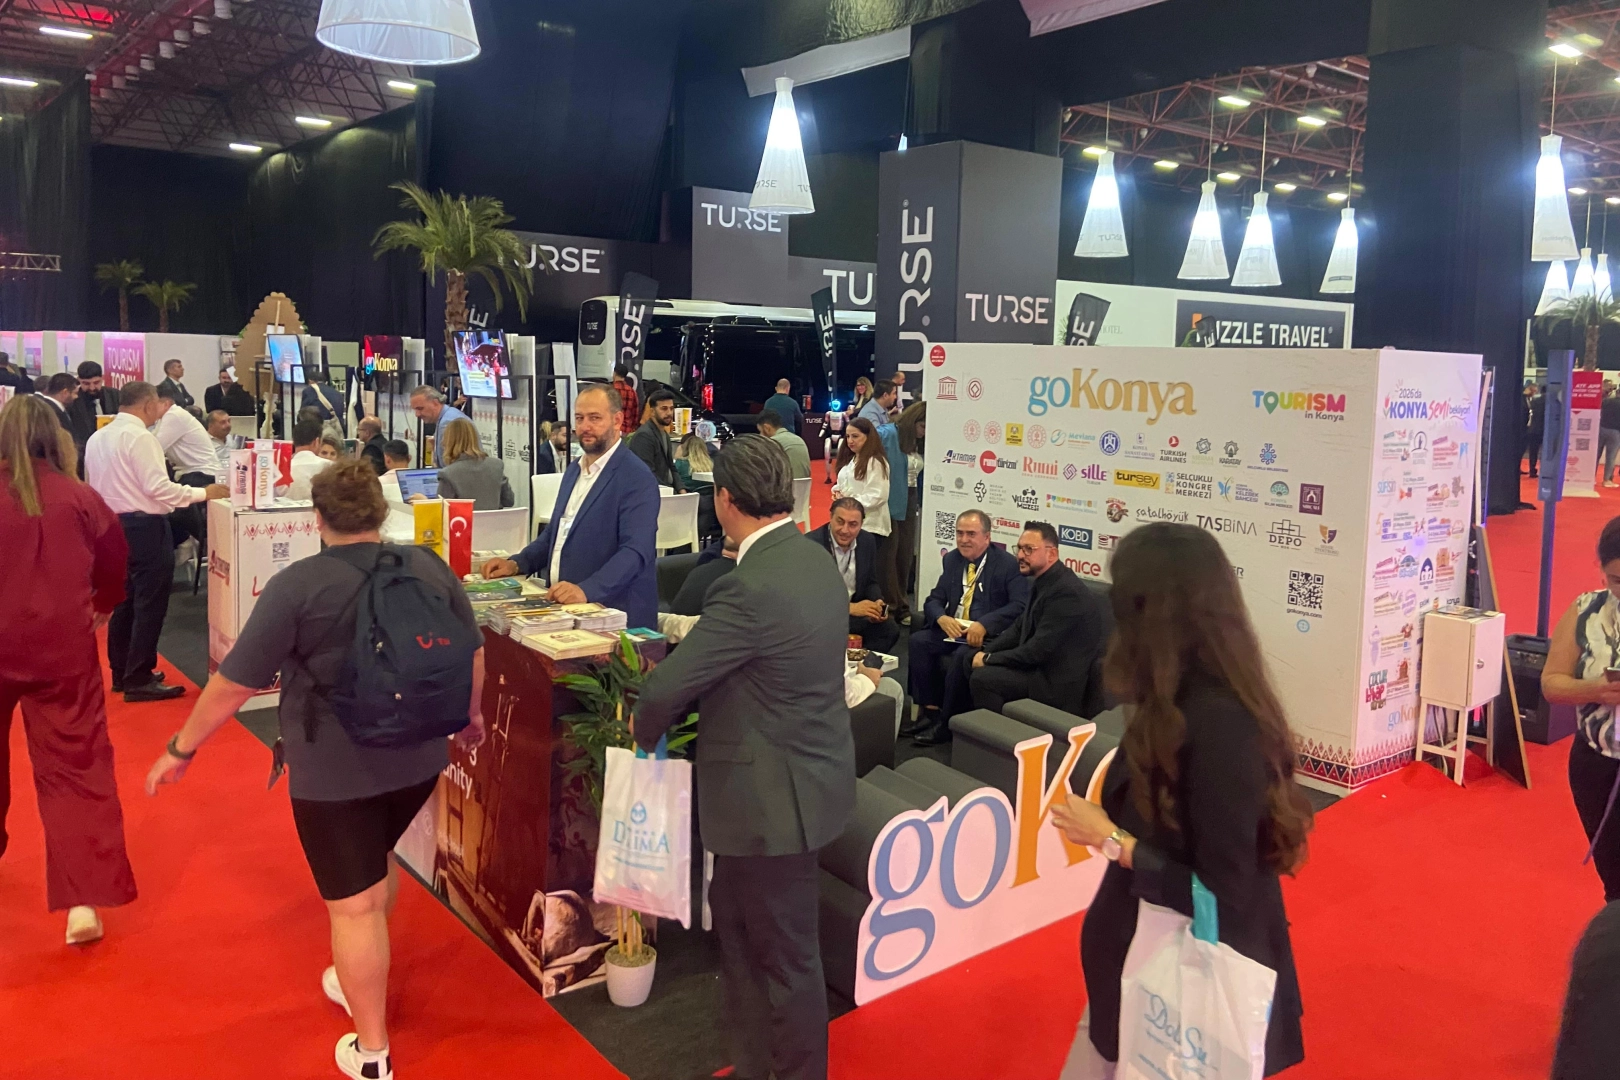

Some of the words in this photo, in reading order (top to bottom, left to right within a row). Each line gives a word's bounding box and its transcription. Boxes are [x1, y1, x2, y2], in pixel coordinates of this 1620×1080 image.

[1269, 323, 1329, 348] TRAVEL
[107, 347, 140, 372] TOURISM
[1027, 368, 1197, 426] goKonya
[1252, 391, 1346, 414] TOURISM
[1305, 410, 1313, 419] in
[1315, 411, 1345, 424] Konya
[1390, 401, 1428, 419] KONYA
[1068, 432, 1096, 442] Mevlana
[1159, 456, 1187, 464] AIRLINES
[1160, 449, 1188, 458] TURKISH
[258, 455, 270, 497] goKonya
[1115, 471, 1159, 487] tursey
[1176, 473, 1214, 484] SELÇUKLU
[1175, 481, 1213, 491] KONGRE
[1174, 489, 1213, 499] MERKEZİ
[995, 516, 1021, 529] TÜRSAB
[1060, 530, 1090, 544] KOBD
[1268, 534, 1302, 546] DEPO
